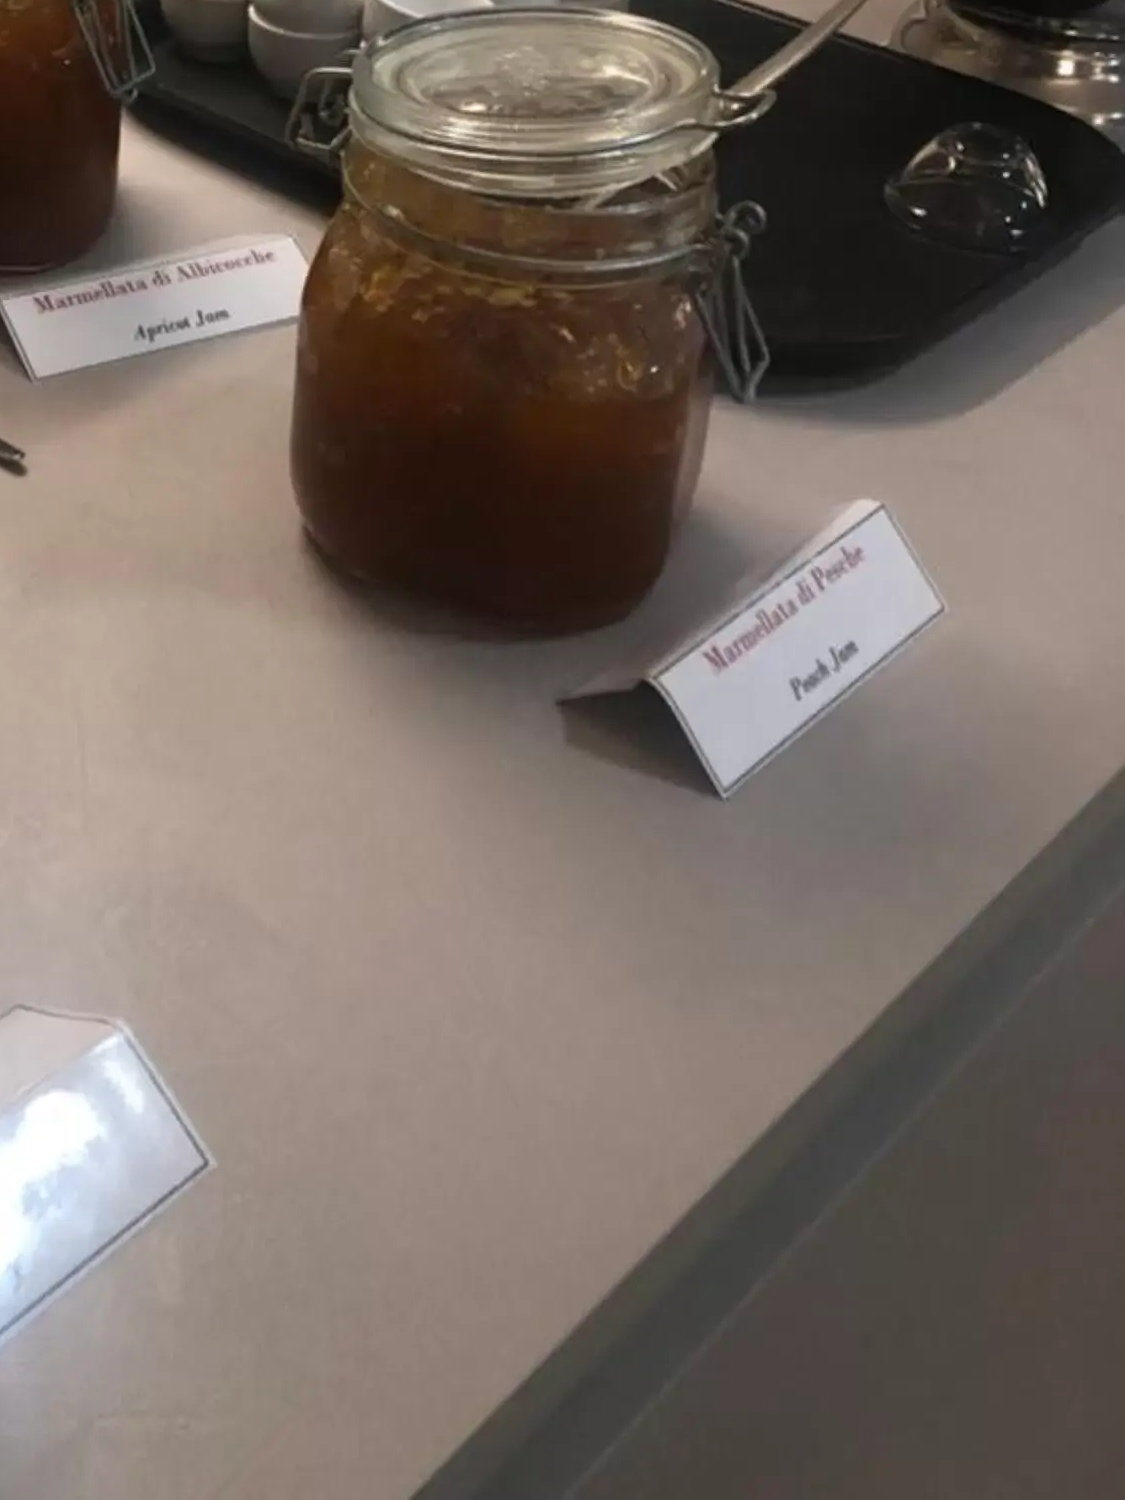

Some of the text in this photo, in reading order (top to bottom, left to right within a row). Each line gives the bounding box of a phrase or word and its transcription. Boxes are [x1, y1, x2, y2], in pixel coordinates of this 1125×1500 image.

[33, 249, 278, 314] Marmellata di Albicocche
[134, 307, 231, 344] Apricot Jam
[703, 543, 868, 676] Marmellata di Pesche
[789, 638, 860, 702] Peach Jam
